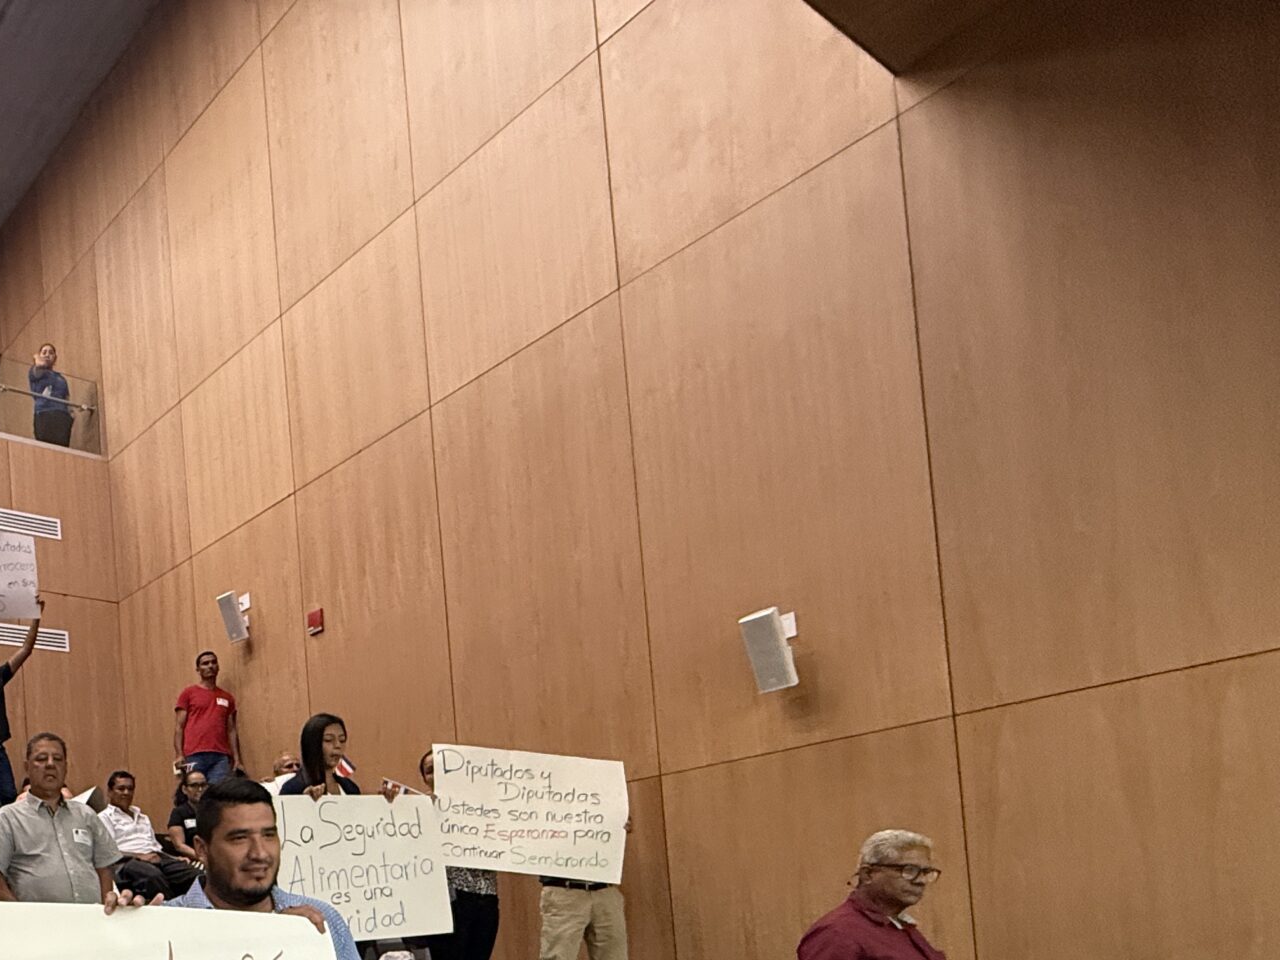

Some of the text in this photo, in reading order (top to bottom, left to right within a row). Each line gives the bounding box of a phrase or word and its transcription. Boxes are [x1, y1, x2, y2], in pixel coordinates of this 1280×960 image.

[437, 749, 552, 787] Diputados y
[497, 781, 601, 805] Diputadas
[437, 797, 604, 825] Ustedes son nuestra
[281, 800, 423, 855] La Seguridad
[440, 818, 611, 845] única Esperanza para
[510, 846, 609, 868] Sembrando
[289, 852, 434, 897] Alimentaria
[331, 886, 393, 905] es una
